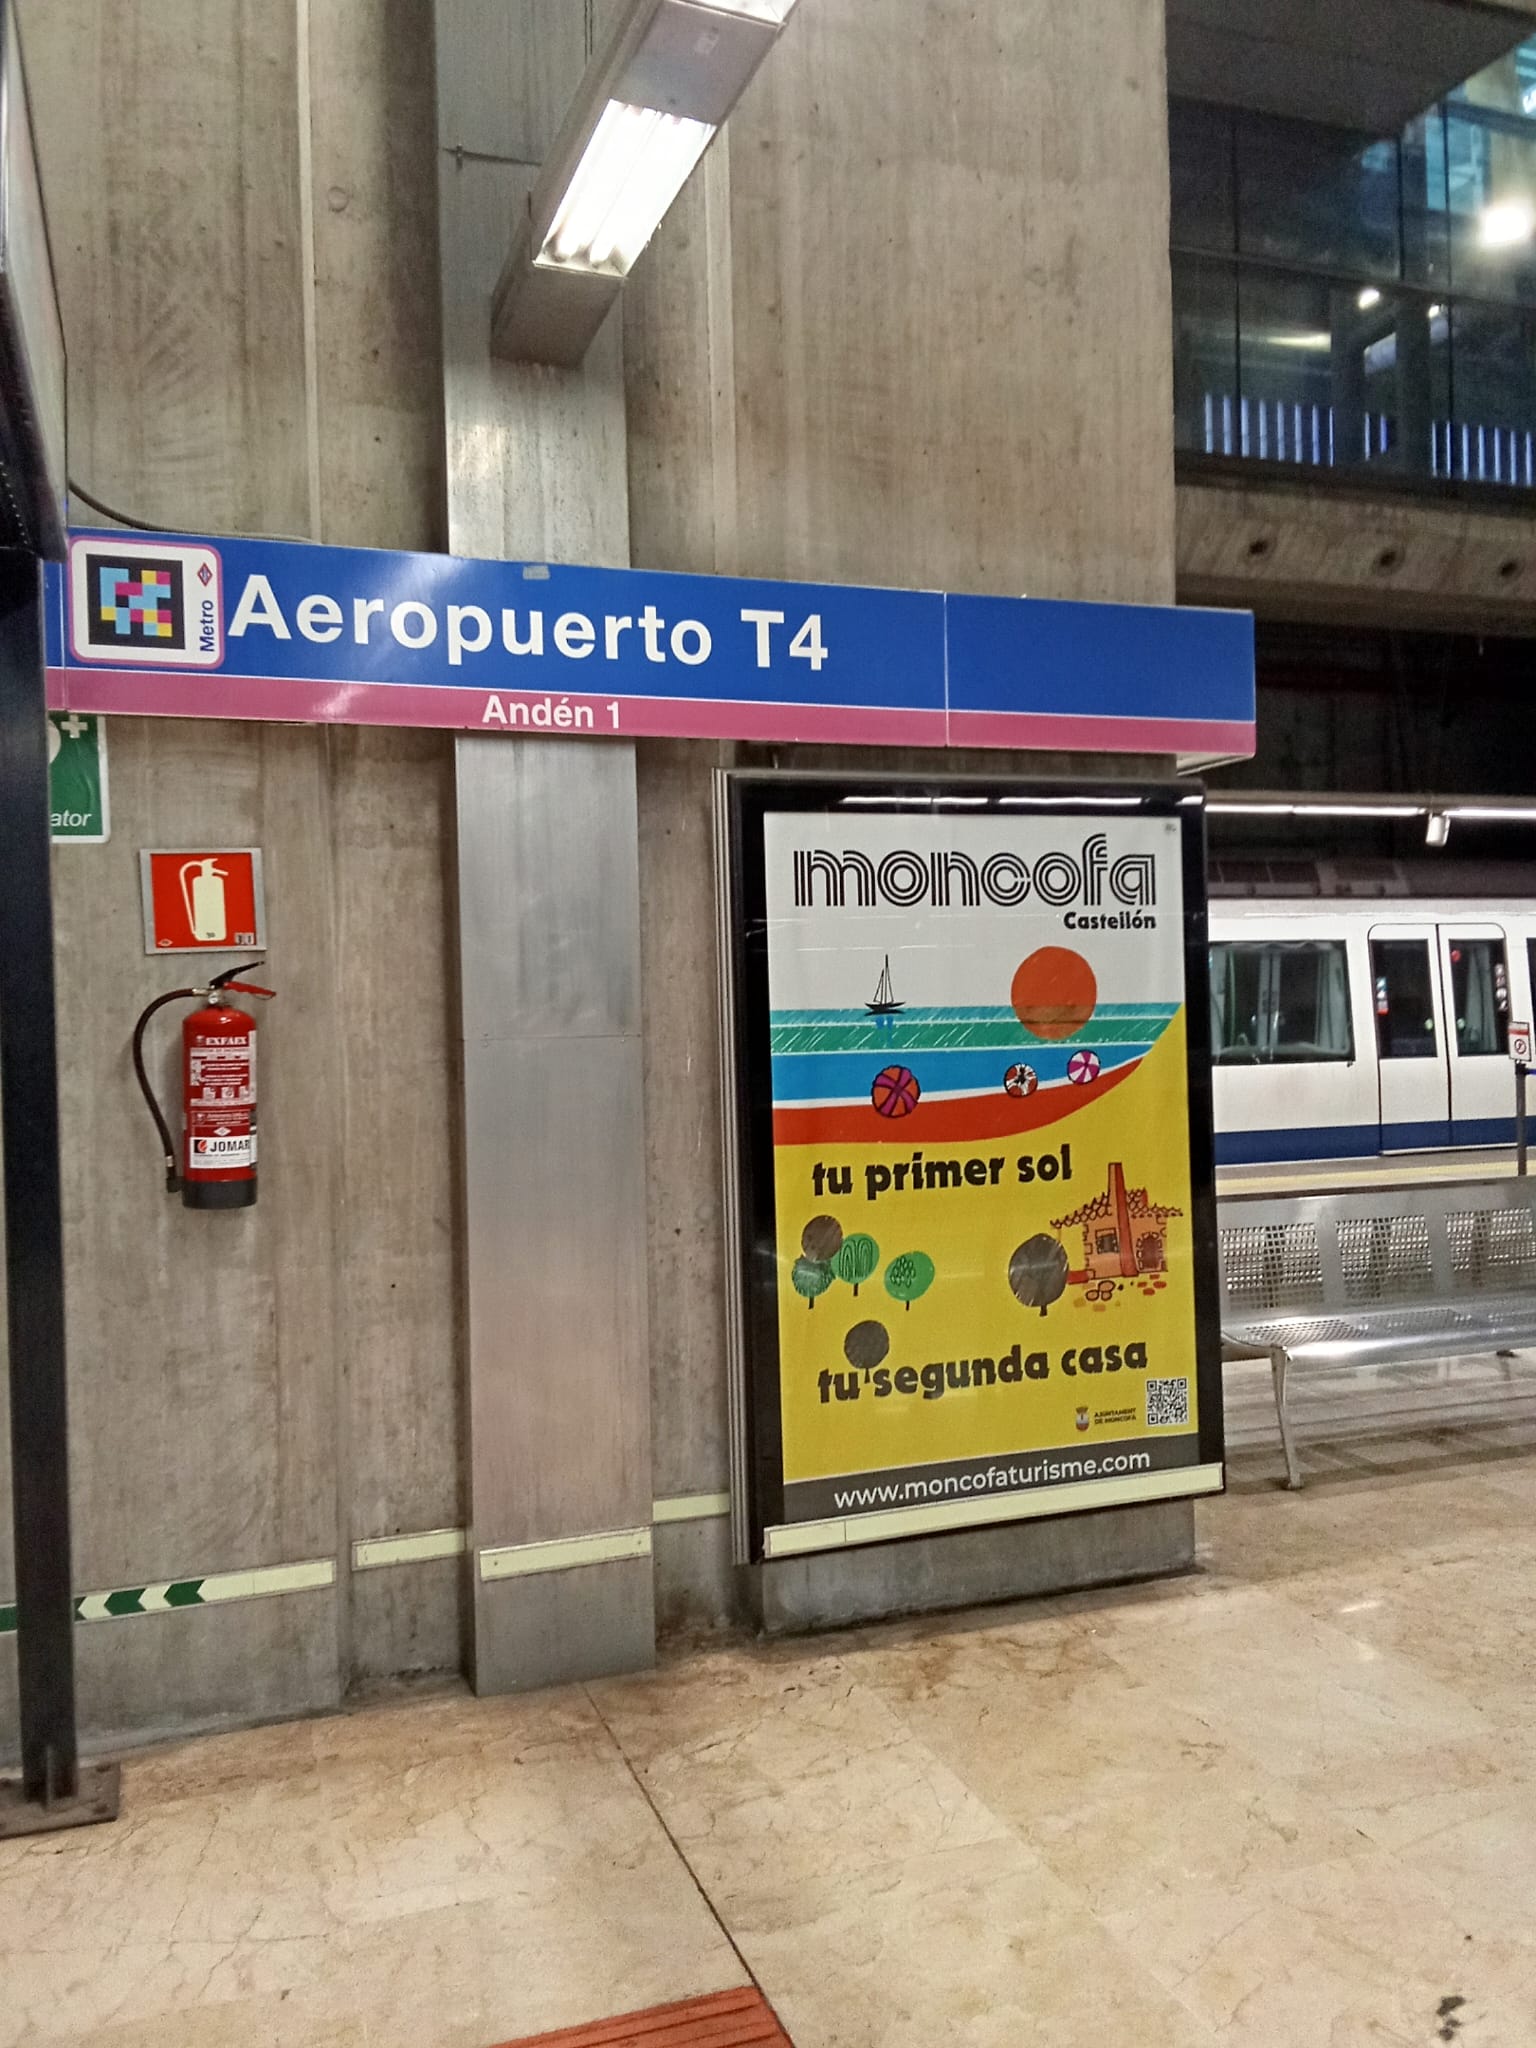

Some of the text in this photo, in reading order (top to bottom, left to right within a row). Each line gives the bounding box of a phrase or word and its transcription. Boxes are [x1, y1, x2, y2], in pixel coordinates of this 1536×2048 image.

[200, 600, 214, 652] Metro
[228, 574, 829, 671] Aeropuerto T4
[482, 695, 620, 729] Andén 1
[50, 809, 92, 827] ator
[793, 833, 1157, 907] moncofa
[1063, 910, 1157, 931] Castellón
[811, 1143, 1073, 1200] tu primer sol
[817, 1341, 1148, 1403] tu segunda casa
[834, 1451, 1151, 1510] www.moncofaturisme.com
